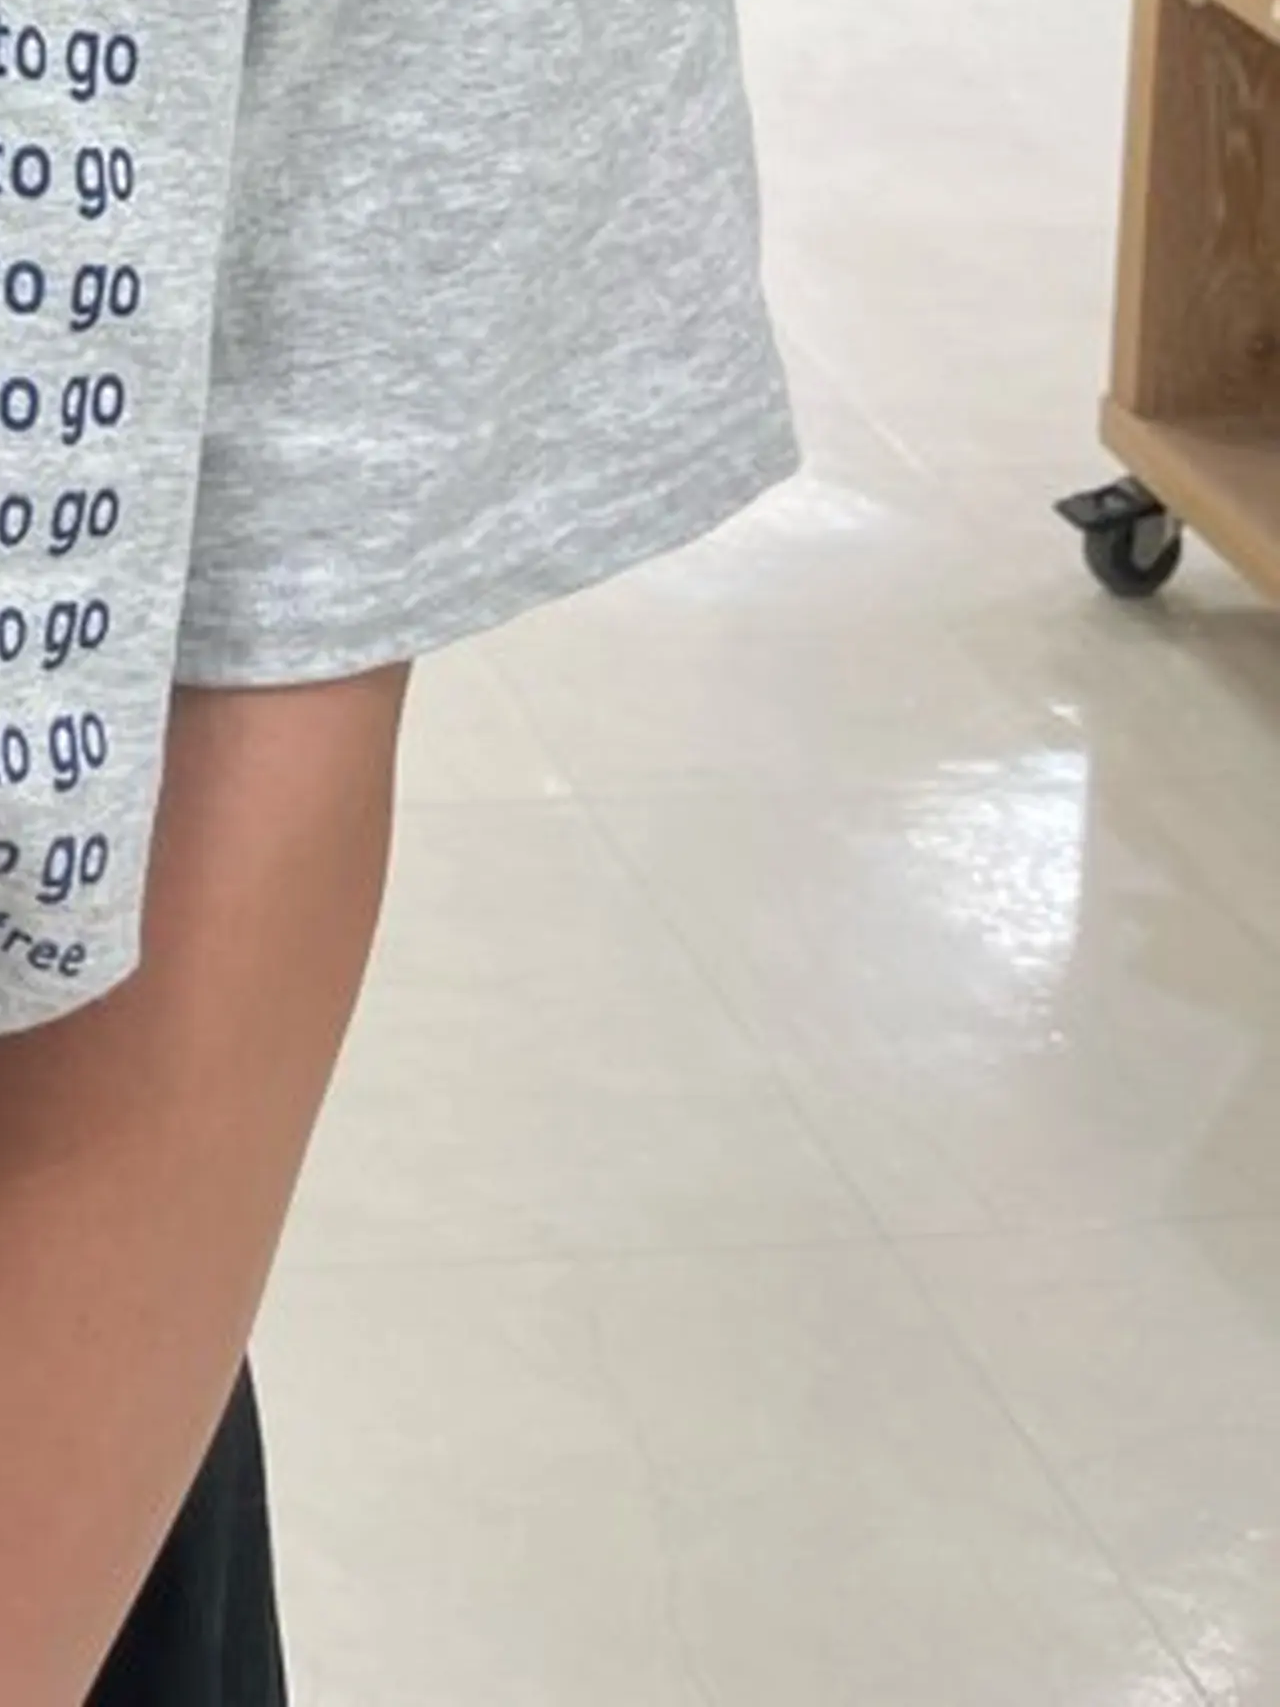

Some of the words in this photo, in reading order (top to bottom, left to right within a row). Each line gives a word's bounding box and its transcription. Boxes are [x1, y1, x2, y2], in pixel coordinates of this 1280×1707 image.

[65, 30, 139, 103] go
[74, 147, 134, 221] go
[69, 264, 141, 333] go
[61, 373, 125, 446] go
[47, 487, 120, 559] go
[41, 598, 110, 672] go
[49, 712, 107, 793] go
[35, 833, 109, 906] go
